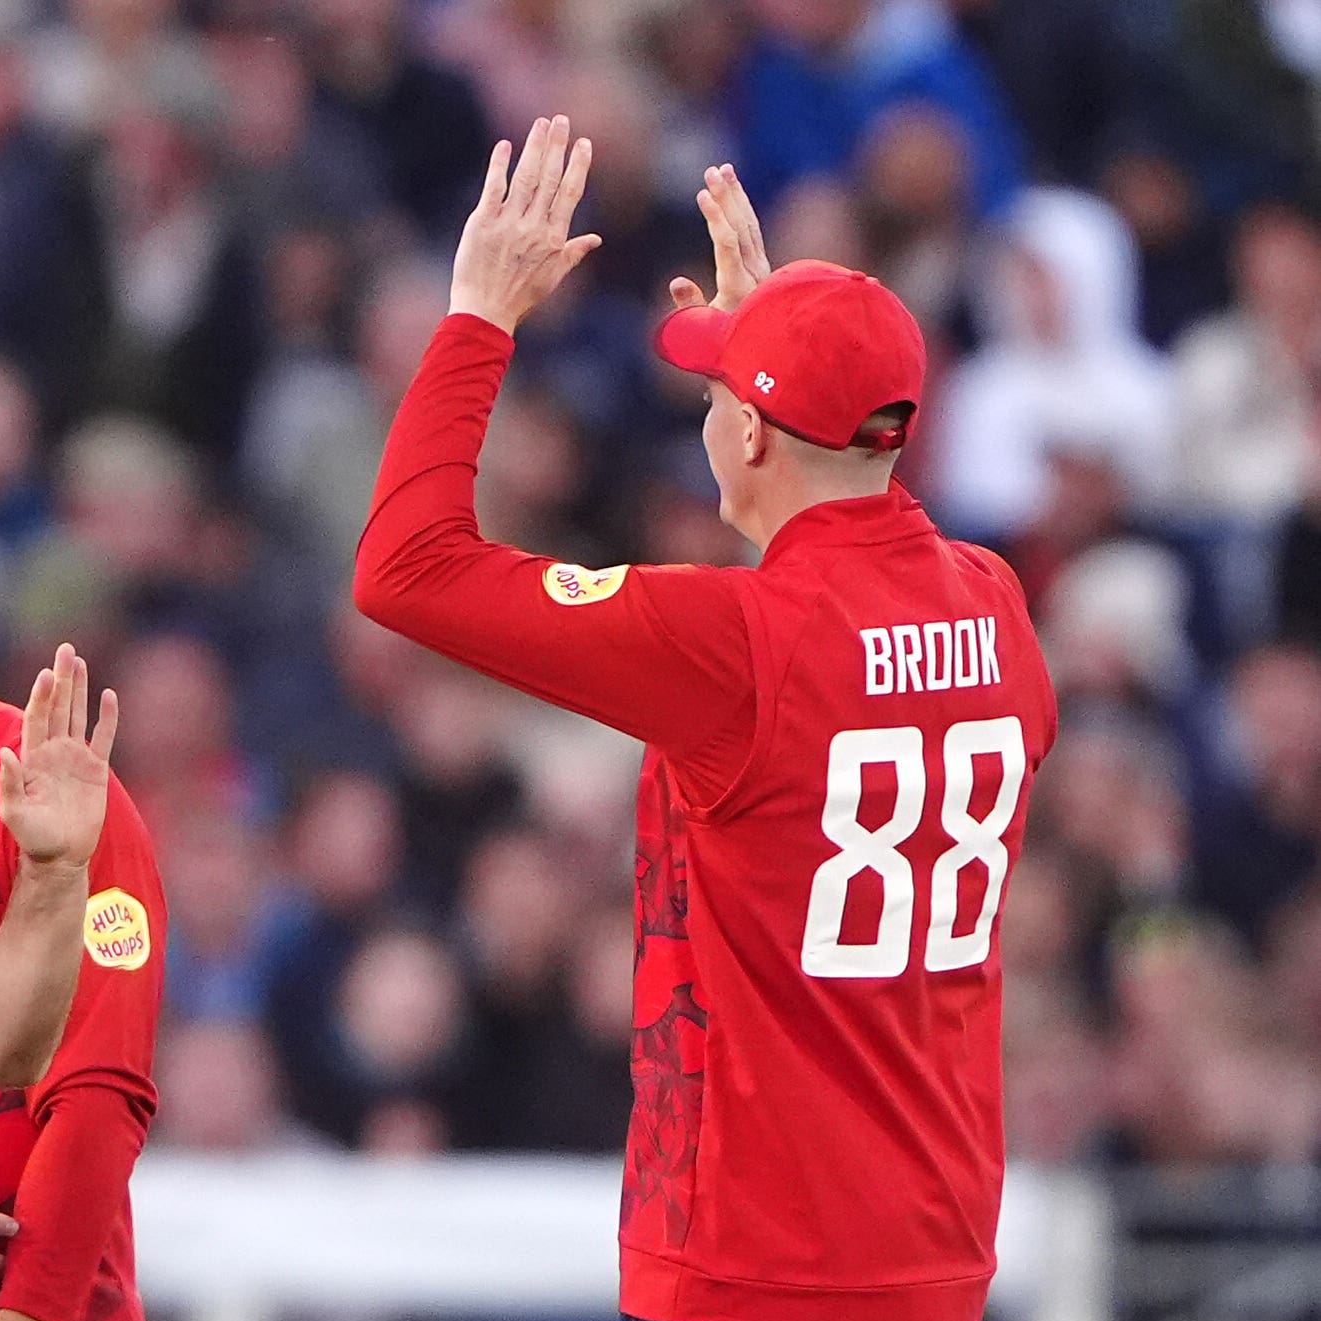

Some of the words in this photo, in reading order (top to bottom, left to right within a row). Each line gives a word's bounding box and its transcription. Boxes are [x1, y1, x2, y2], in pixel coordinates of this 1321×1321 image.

[754, 370, 775, 394] 92
[557, 568, 586, 599] OPS
[859, 616, 1002, 696] BROOK
[801, 715, 1026, 978] 88
[92, 903, 133, 933] HULA
[96, 930, 144, 958] HOOPS
